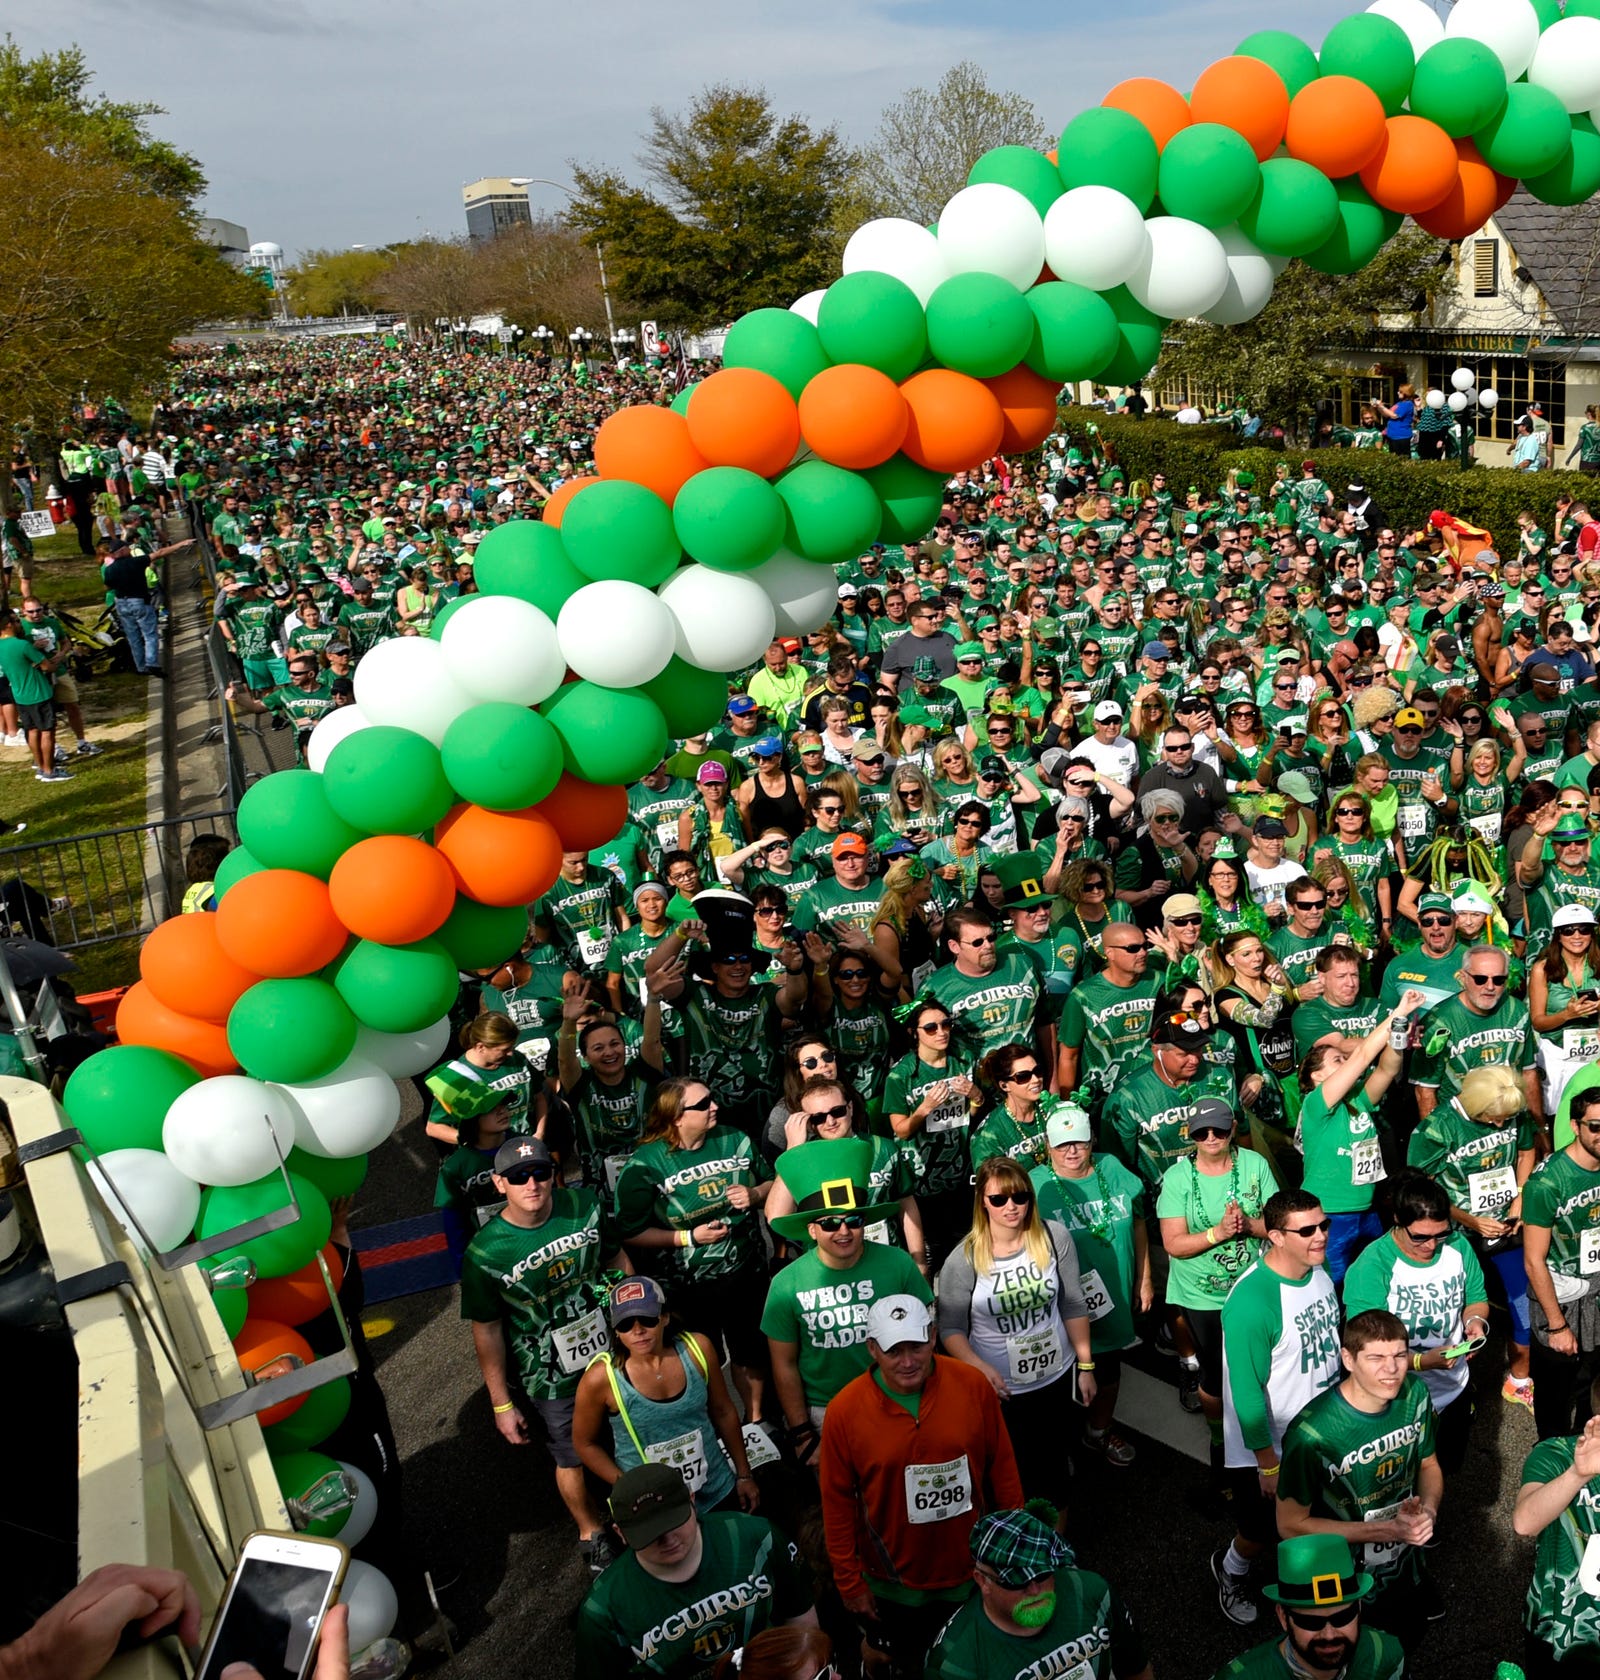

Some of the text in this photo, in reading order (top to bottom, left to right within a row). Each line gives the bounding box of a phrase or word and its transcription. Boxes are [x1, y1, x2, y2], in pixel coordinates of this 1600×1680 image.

[1258, 1039, 1293, 1057] GUINNE
[932, 1104, 963, 1123] 3043
[1357, 1156, 1383, 1177] 2213
[1477, 1189, 1514, 1209] 2658
[989, 1262, 1044, 1297] ZERO
[797, 1280, 874, 1311] WHO'S
[987, 1278, 1056, 1317] LUCKS
[1396, 1291, 1465, 1317] DRUNKE
[802, 1304, 870, 1334] YOUR
[997, 1304, 1053, 1334] GIVEN
[1299, 1313, 1341, 1345] DRUNKE
[566, 1331, 609, 1363] 7610
[811, 1323, 869, 1350] LADD
[1016, 1350, 1058, 1375] 8797
[914, 1485, 965, 1512] 6298
[630, 1574, 773, 1665] McGUIRE'S
